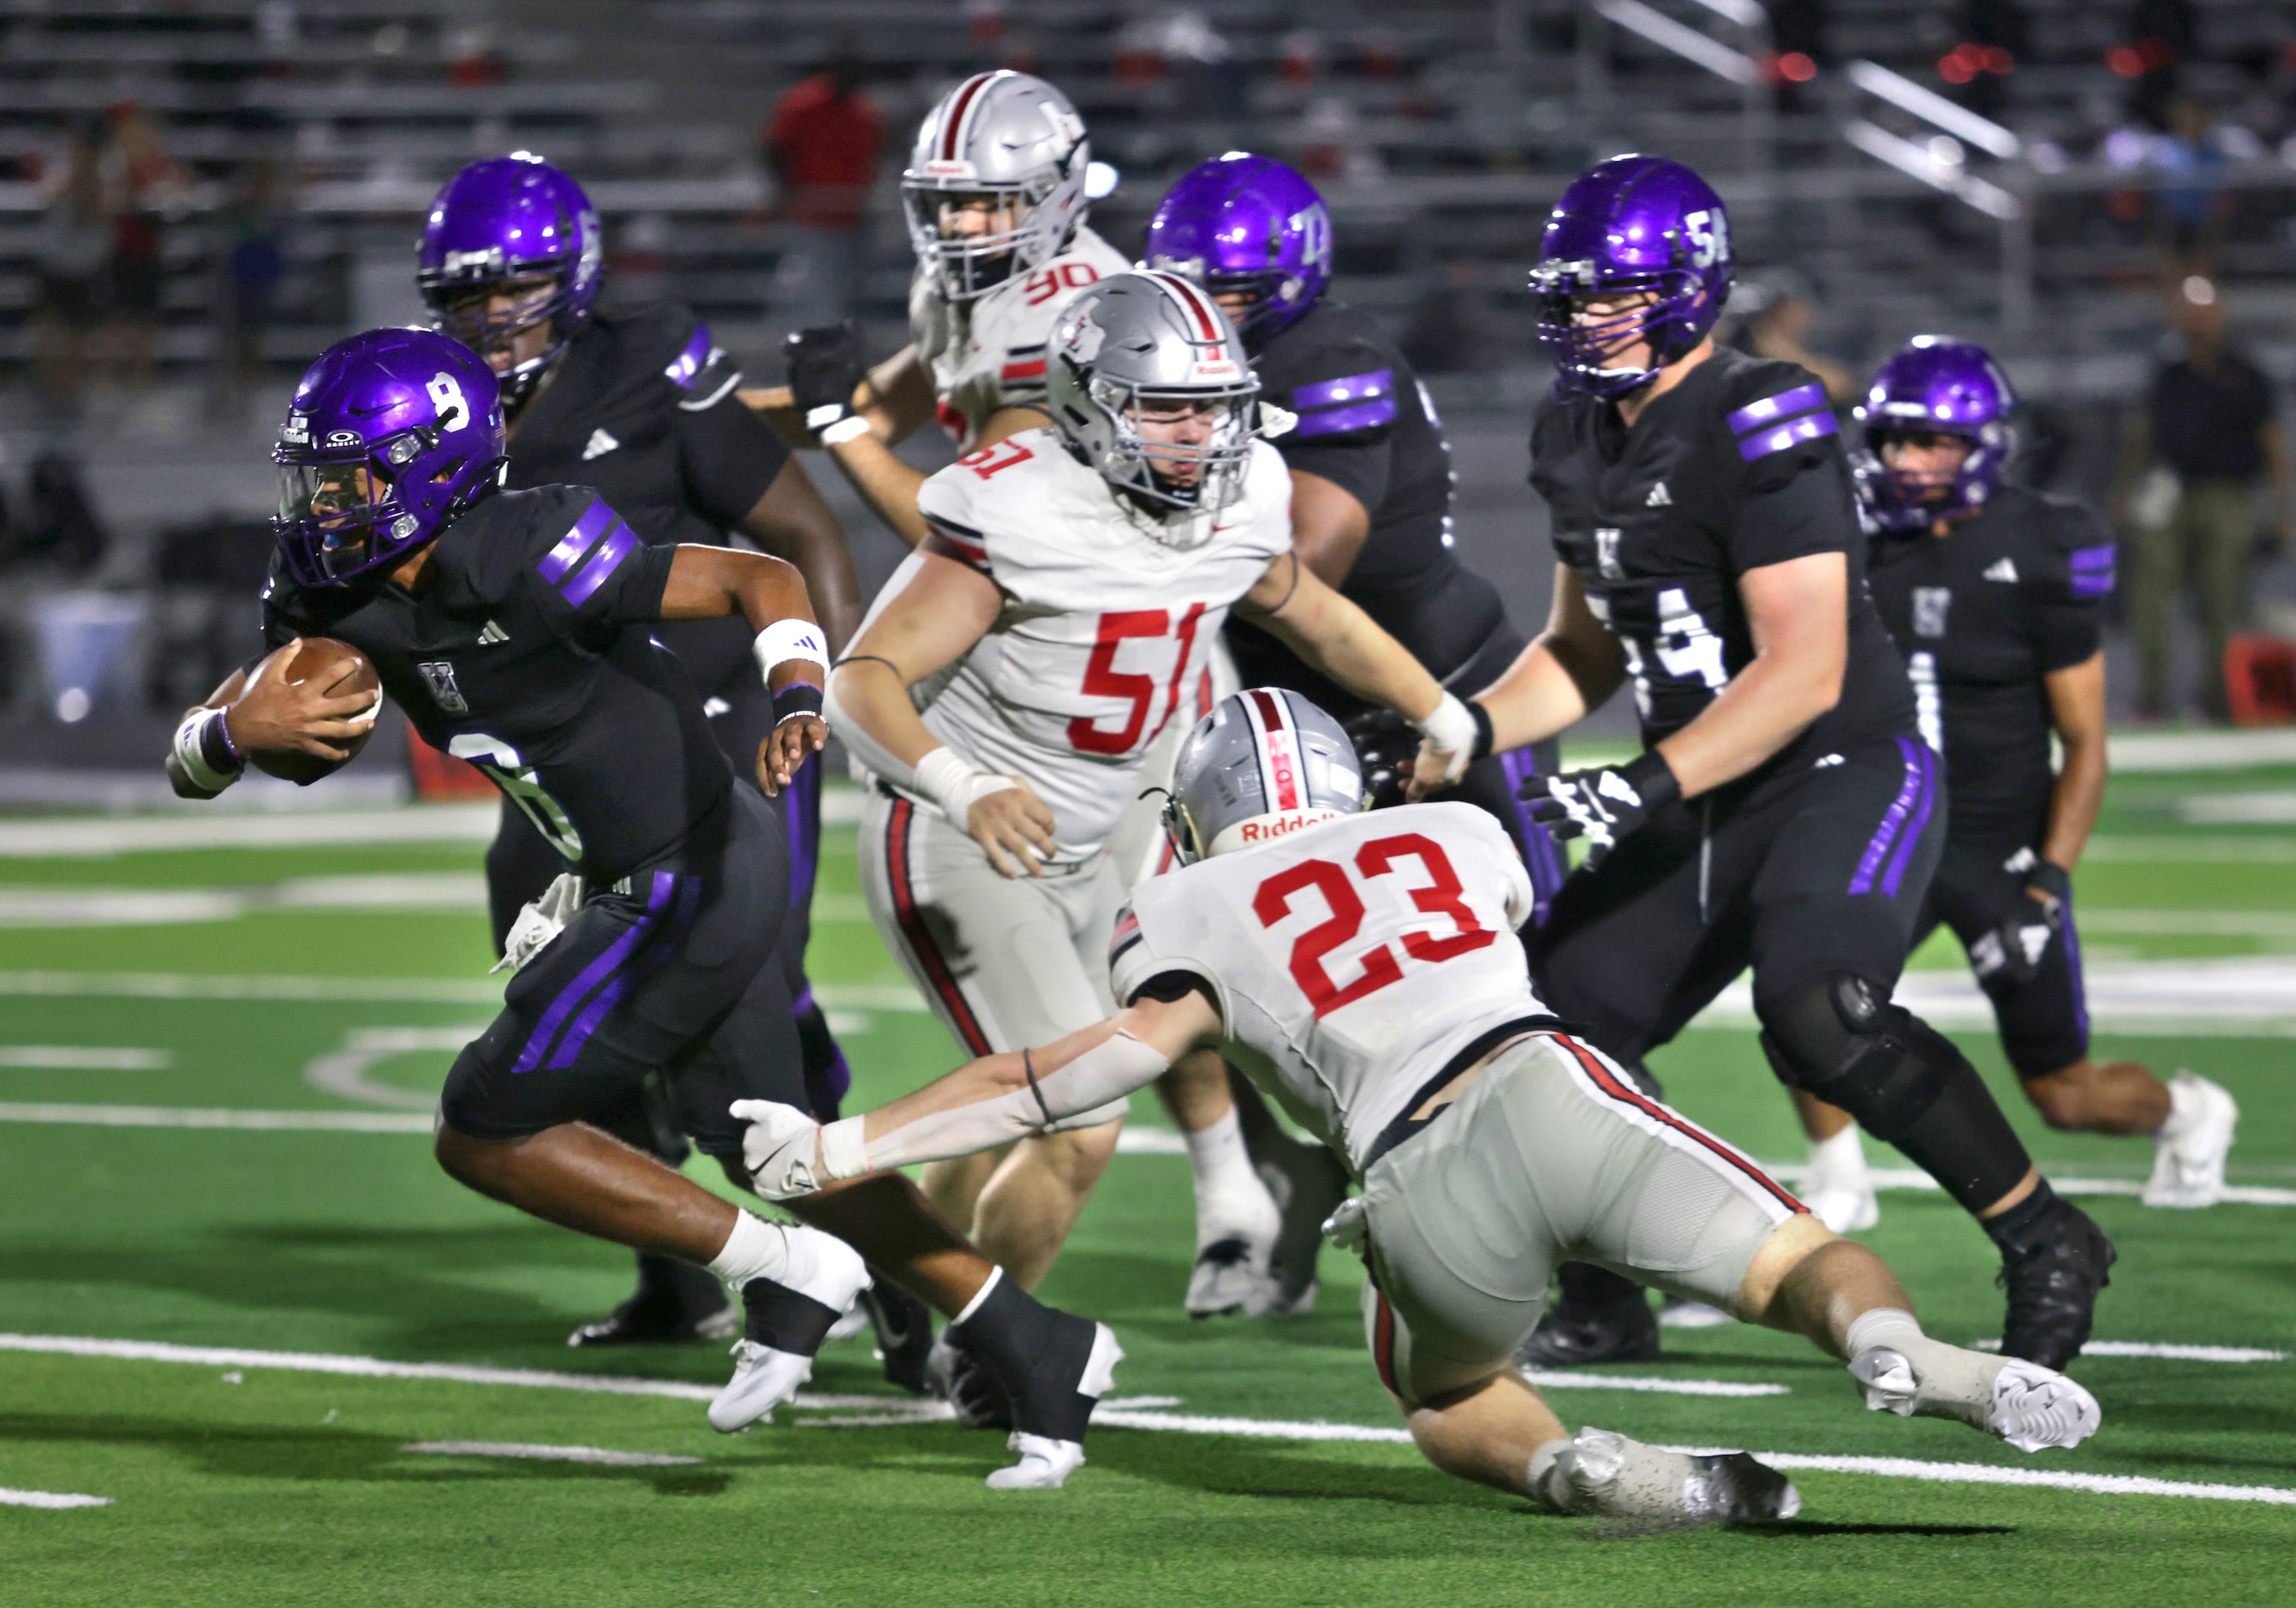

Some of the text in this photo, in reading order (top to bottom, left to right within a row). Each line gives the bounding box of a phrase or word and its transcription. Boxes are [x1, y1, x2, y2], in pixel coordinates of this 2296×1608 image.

[1684, 207, 1729, 268] 54
[1024, 264, 1098, 305] 90
[426, 372, 470, 433] 8
[1066, 602, 1206, 755] 51
[1252, 832, 1497, 1022] 23
